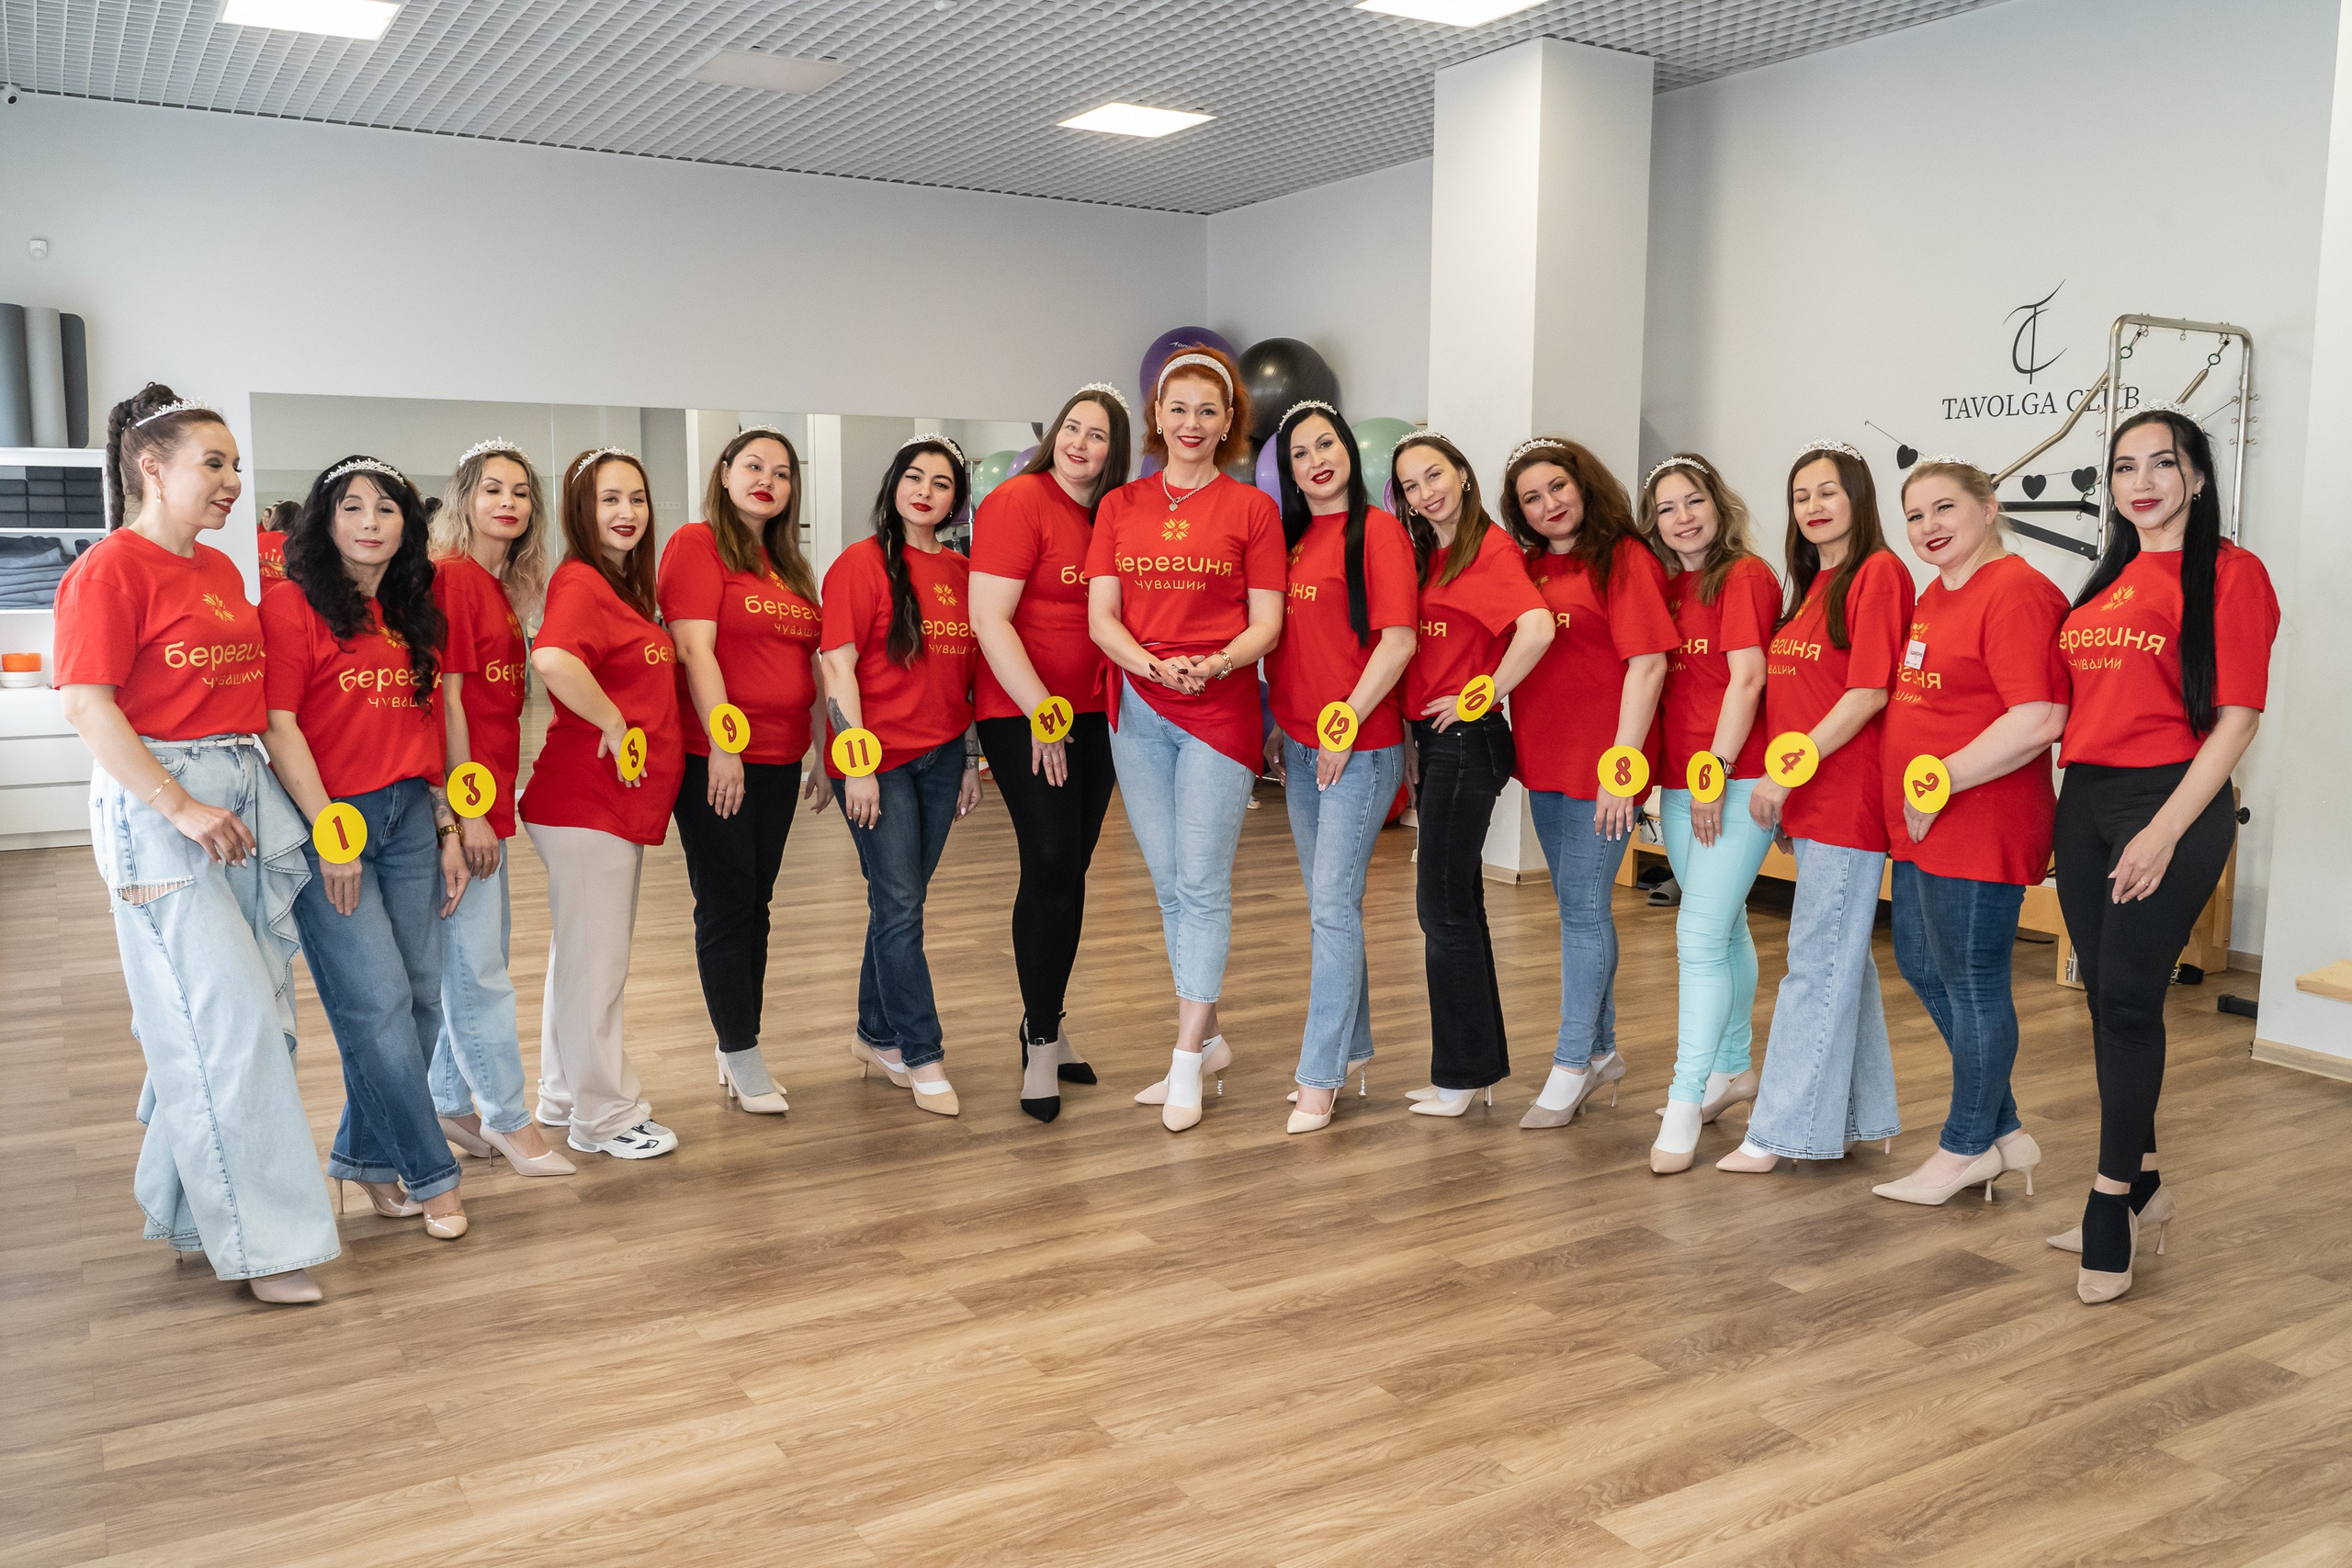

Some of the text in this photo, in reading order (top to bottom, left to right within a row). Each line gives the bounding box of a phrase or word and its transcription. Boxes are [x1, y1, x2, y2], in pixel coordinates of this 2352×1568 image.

[1942, 391, 2058, 420] TAVOLGA
[1135, 580, 1206, 591] чувашии
[2059, 626, 2166, 656] ерегиня
[1464, 682, 1487, 711] 10
[722, 714, 737, 743] 9
[1039, 703, 1067, 735] 14
[1323, 709, 1350, 745] 12
[628, 738, 639, 769] 5
[845, 739, 870, 768] 11
[1781, 749, 1805, 775] 4
[1614, 756, 1632, 786] 8
[1699, 763, 1712, 790] 6
[1912, 773, 1939, 798] 2
[462, 773, 481, 807] 3
[332, 816, 350, 851] 1
